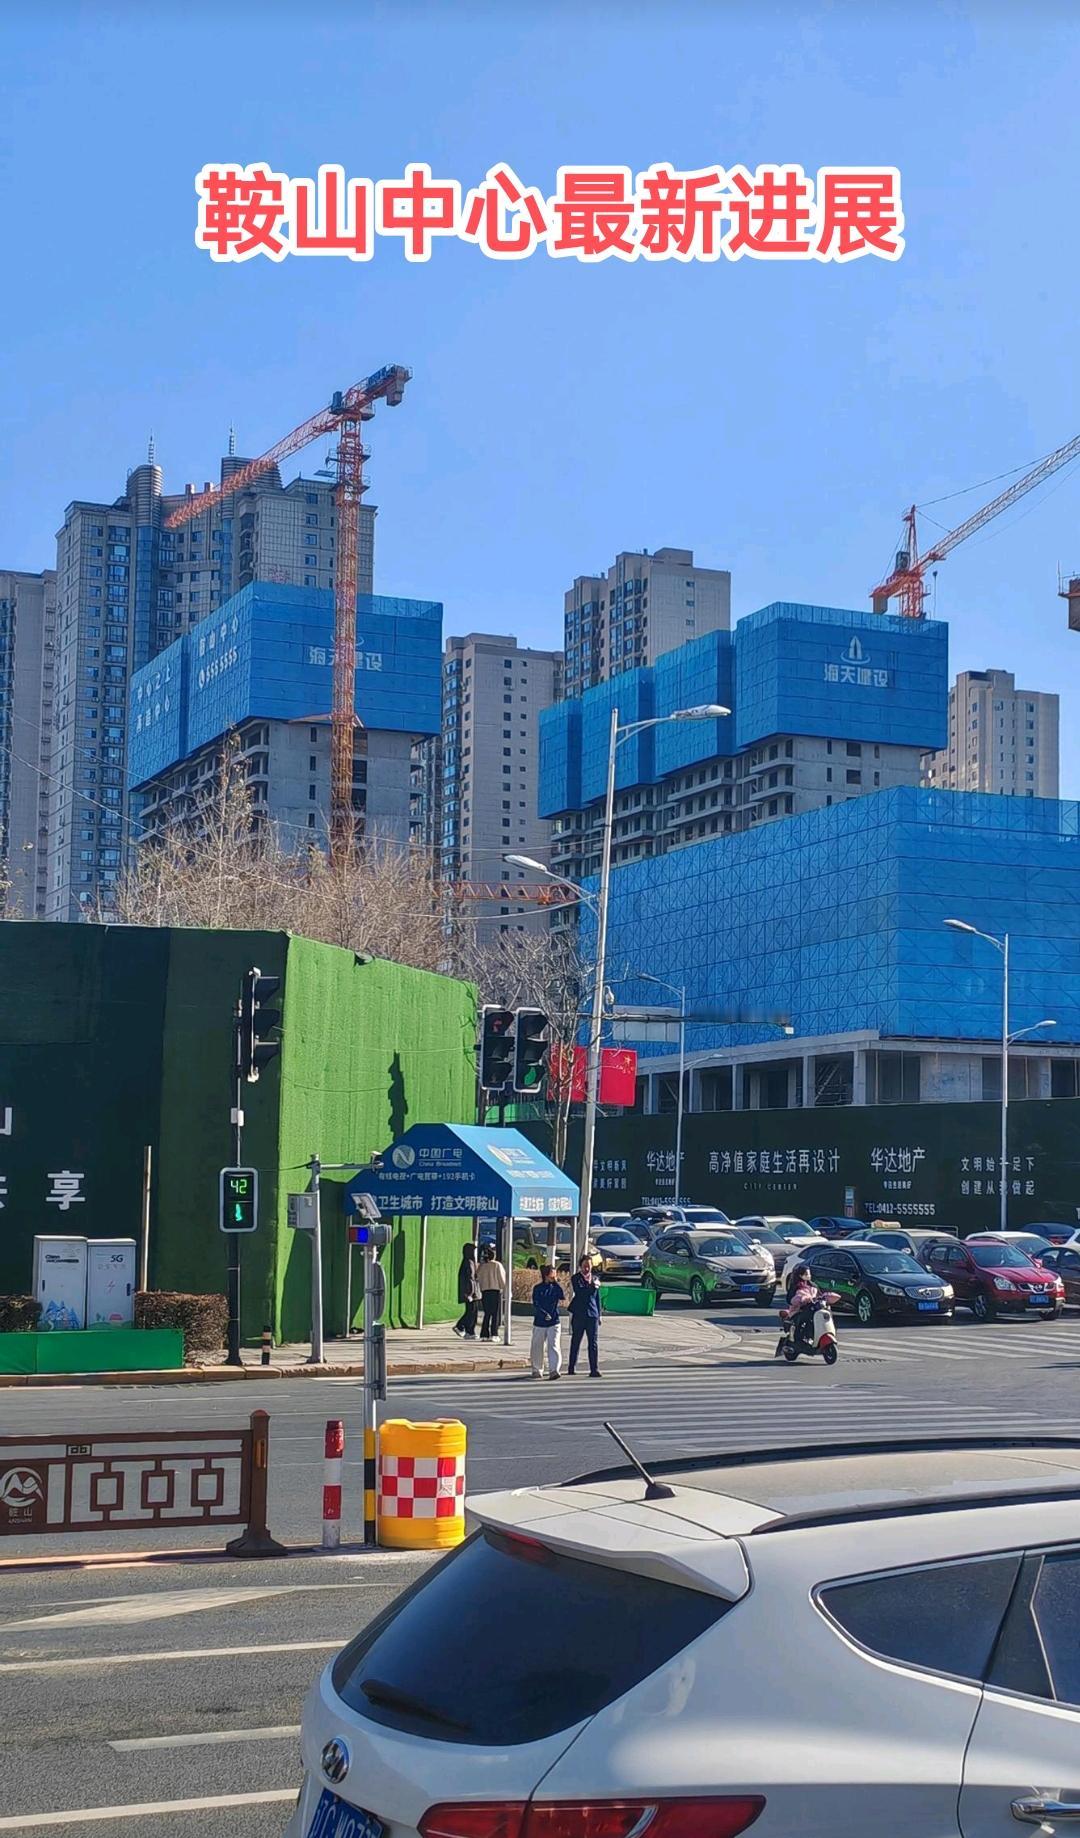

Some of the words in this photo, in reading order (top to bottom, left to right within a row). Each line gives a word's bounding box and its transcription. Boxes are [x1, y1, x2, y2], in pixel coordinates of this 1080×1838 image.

[824, 663, 888, 687] 海天建设
[419, 1148, 462, 1158] 中国广电
[709, 1148, 840, 1173] 高净值家庭生活再设计
[871, 1147, 925, 1172] 华达地产
[231, 1179, 247, 1194] 42
[373, 1195, 423, 1210] 卫生城市
[431, 1195, 499, 1211] 打造文明鞍山
[110, 1254, 123, 1262] 5G
